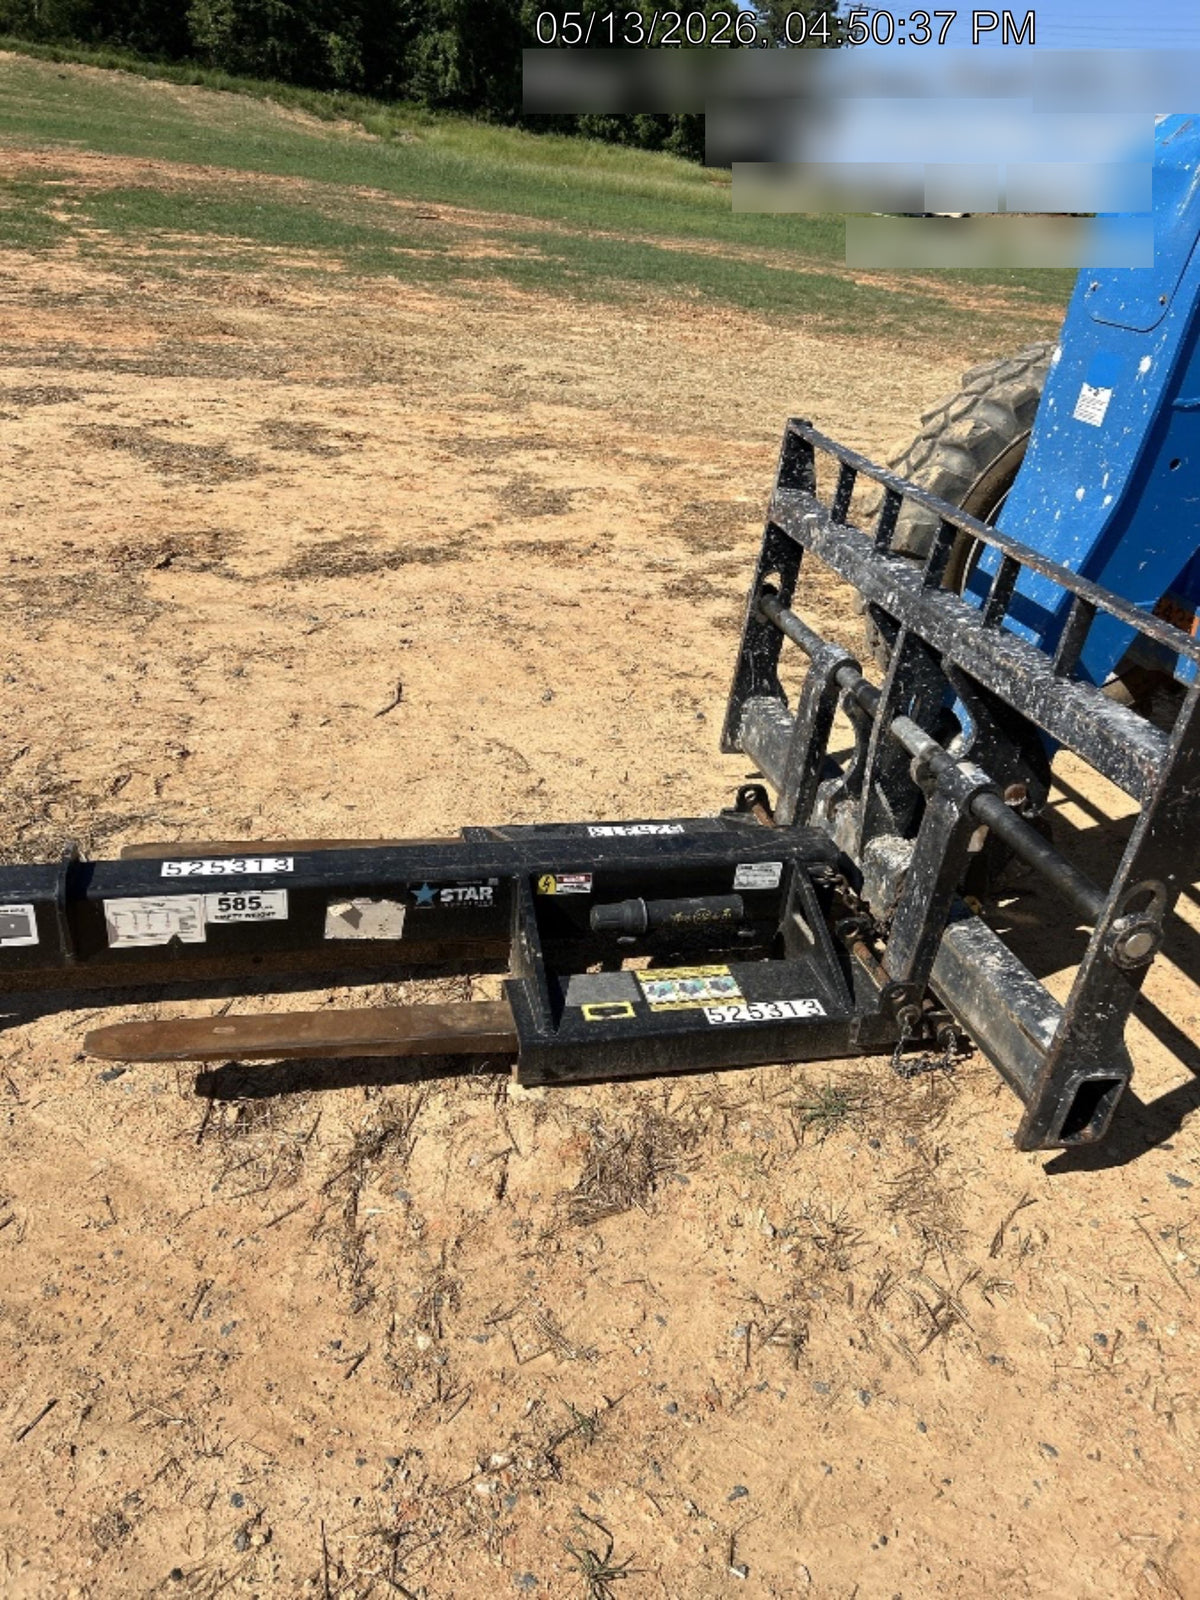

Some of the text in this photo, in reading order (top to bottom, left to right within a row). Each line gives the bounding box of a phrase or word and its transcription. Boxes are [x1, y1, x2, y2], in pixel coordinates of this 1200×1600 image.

[165, 859, 289, 875] 525313
[440, 886, 493, 902] STAR
[218, 896, 261, 912] 585
[707, 999, 821, 1023] 525313
